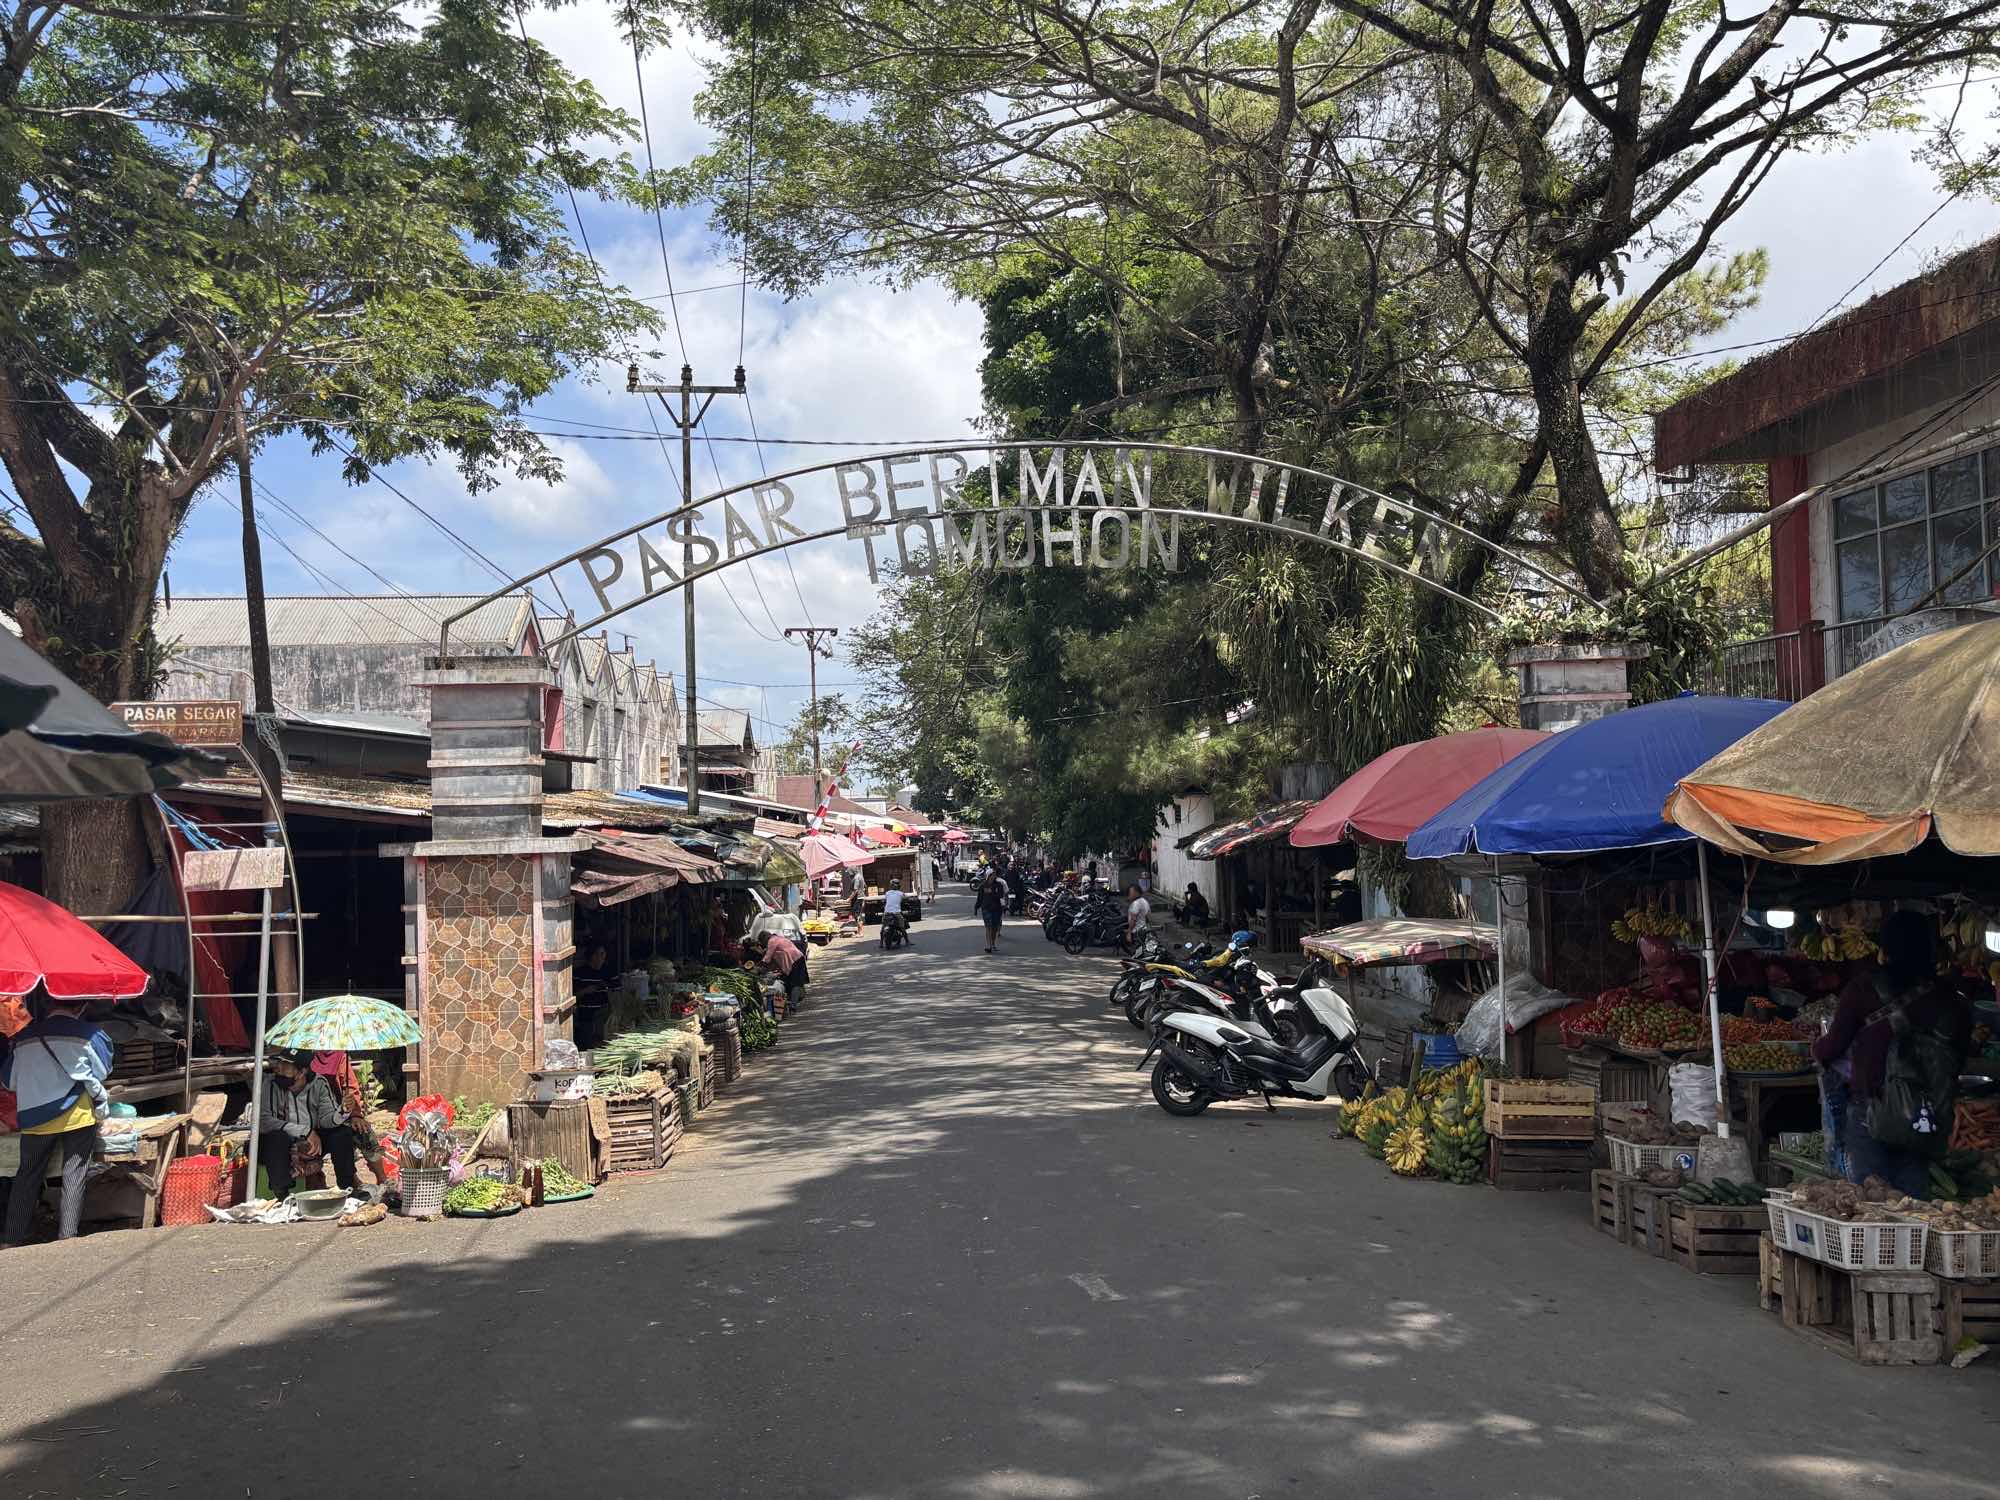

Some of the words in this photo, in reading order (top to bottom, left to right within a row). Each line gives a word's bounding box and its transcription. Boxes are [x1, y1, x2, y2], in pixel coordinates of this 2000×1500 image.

[577, 480, 808, 613] PASAR
[834, 447, 1151, 524] BERIMAN
[1207, 455, 1452, 582] WILKEN
[846, 508, 1179, 585] TOMOHON
[124, 707, 177, 721] PASAR
[183, 706, 237, 720] SEGAR
[177, 726, 237, 738] MARKET
